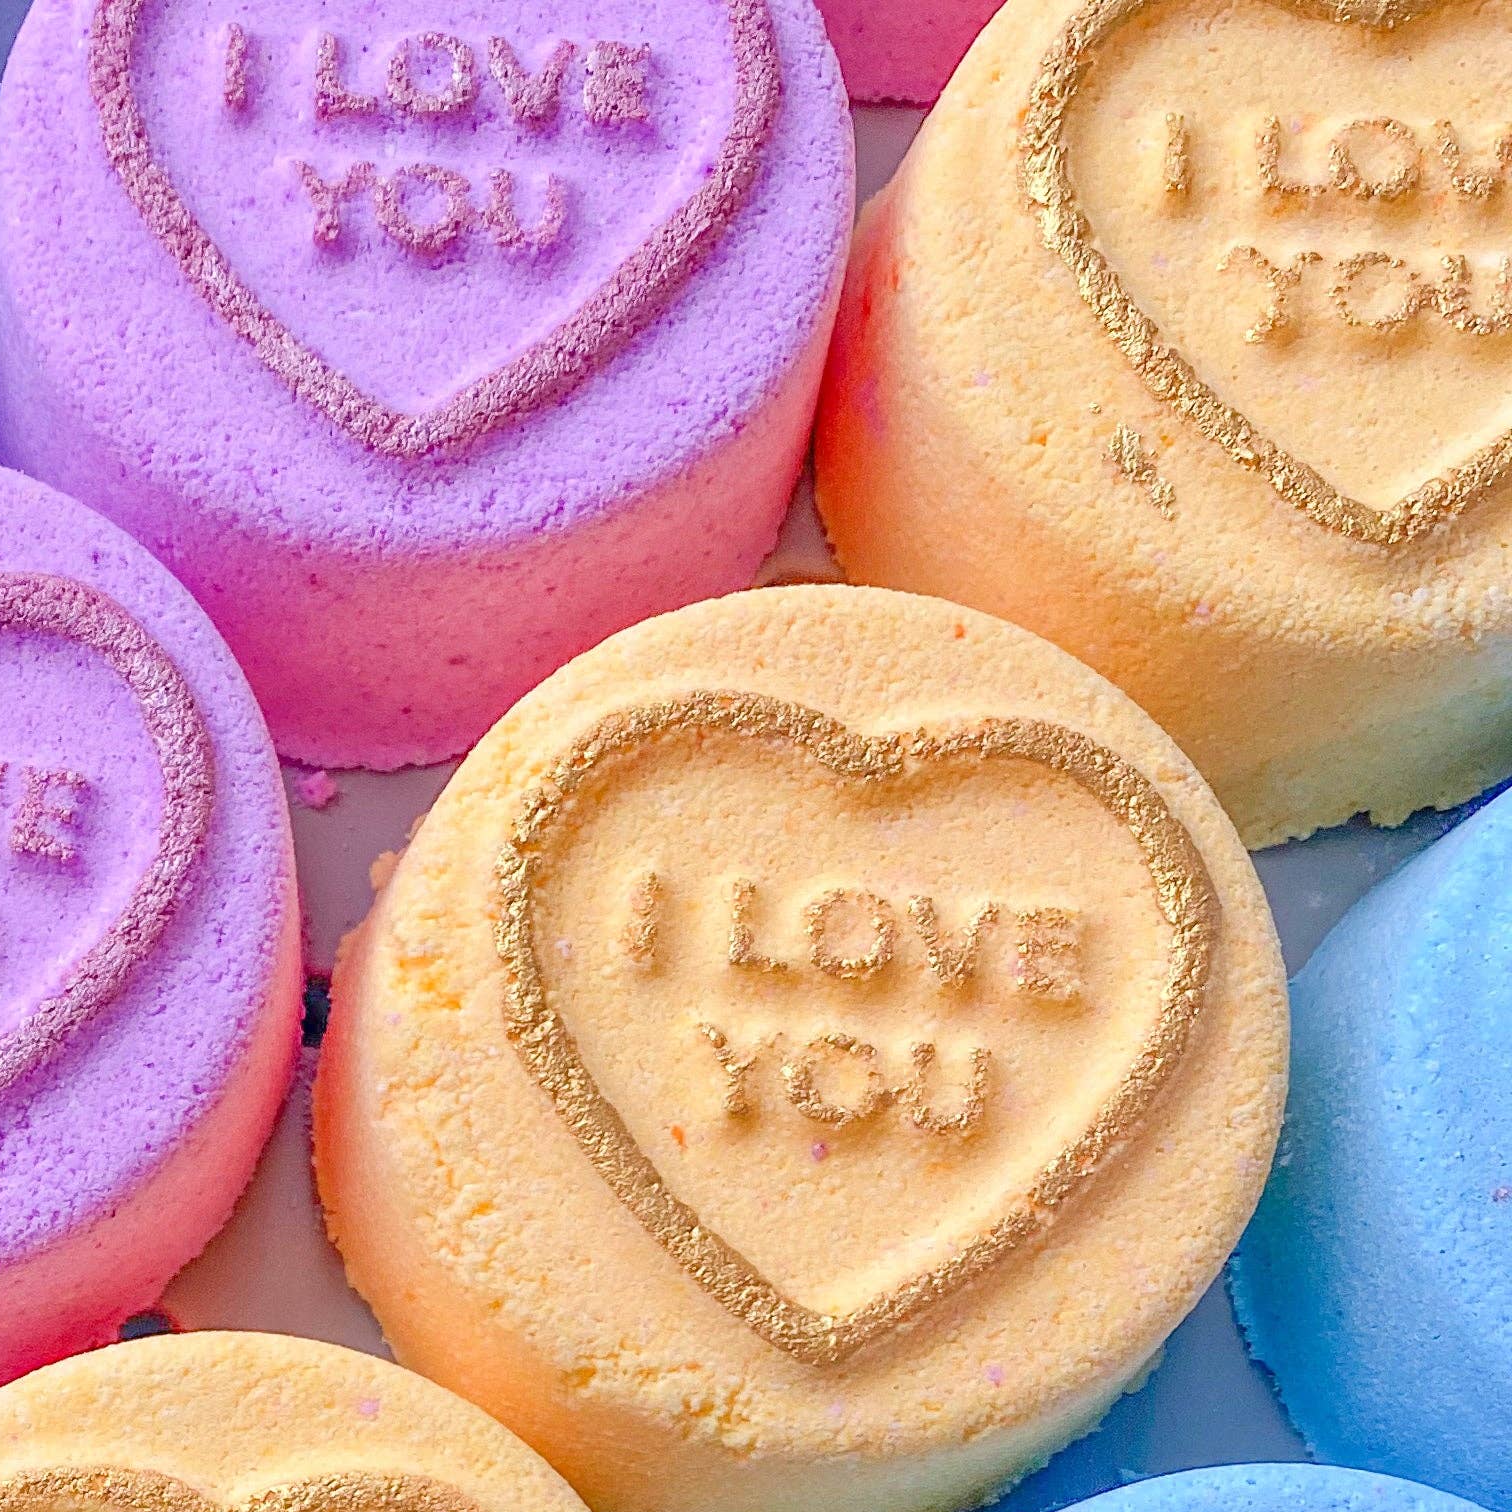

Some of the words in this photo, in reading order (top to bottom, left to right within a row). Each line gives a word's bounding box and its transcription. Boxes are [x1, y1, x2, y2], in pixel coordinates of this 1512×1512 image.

[223, 22, 249, 112] I
[315, 30, 652, 128] LOVE
[1162, 110, 1189, 194] I
[294, 158, 568, 250] YOU
[1215, 243, 1512, 342] YOU
[620, 870, 661, 960] I
[727, 876, 1084, 1000] LOVE
[699, 1020, 993, 1133] YOU
